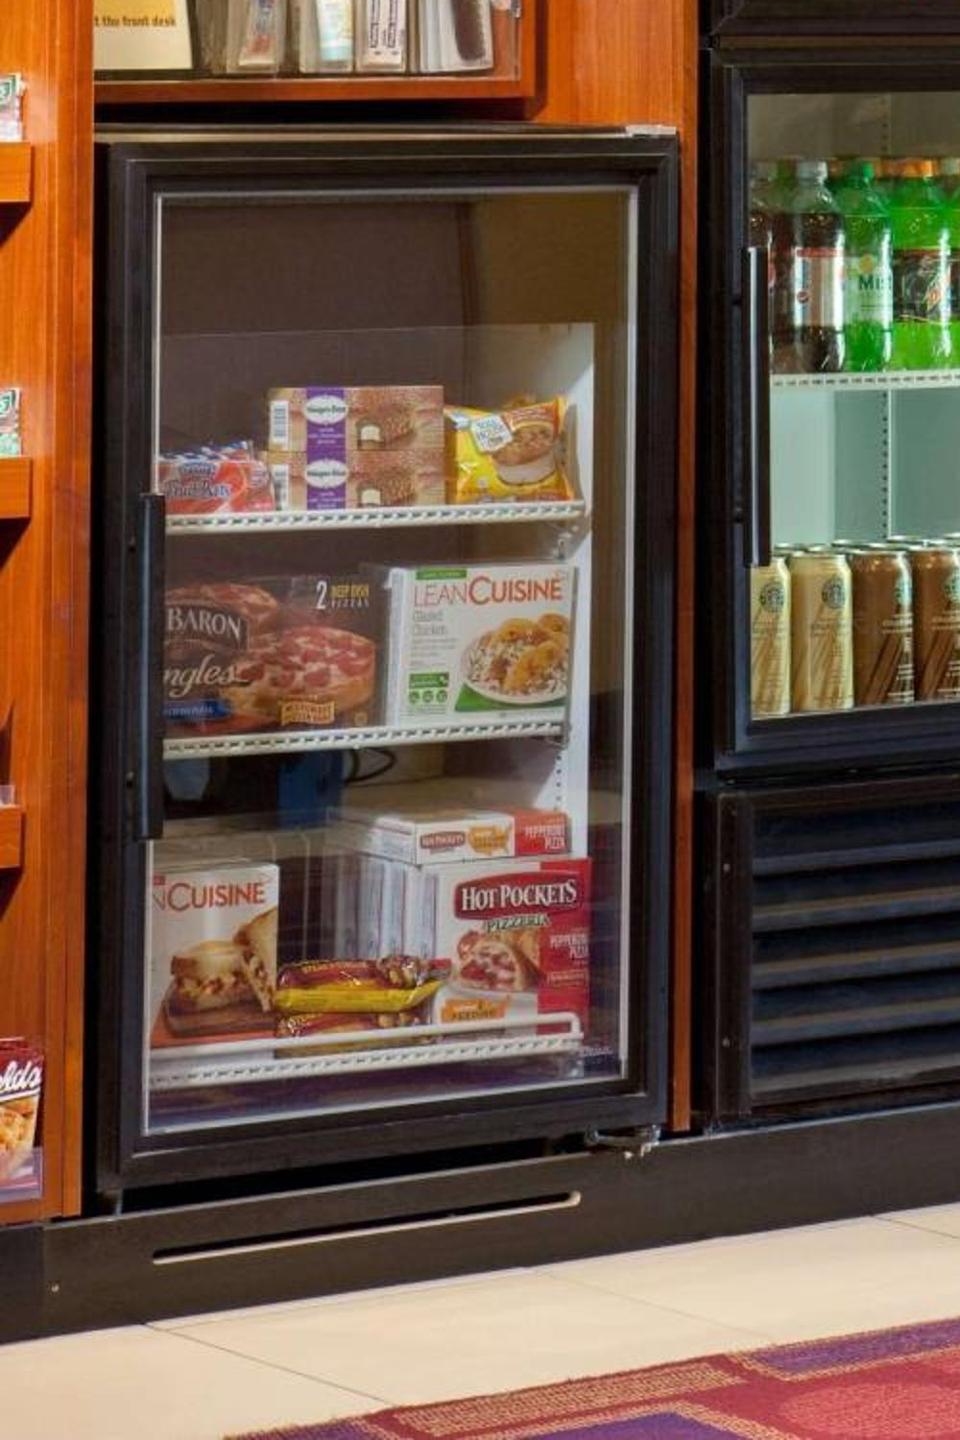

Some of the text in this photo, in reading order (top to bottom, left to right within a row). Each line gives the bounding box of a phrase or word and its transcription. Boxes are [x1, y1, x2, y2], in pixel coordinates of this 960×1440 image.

[102, 15, 120, 27] the
[122, 15, 149, 27] front
[151, 15, 176, 27] desk
[316, 580, 327, 610] 2
[414, 574, 563, 607] LEAN CUISINE
[168, 607, 242, 641] BARON
[164, 653, 249, 697] ngles
[168, 881, 266, 913] CUISINE
[461, 878, 577, 911] HOT POCKETS
